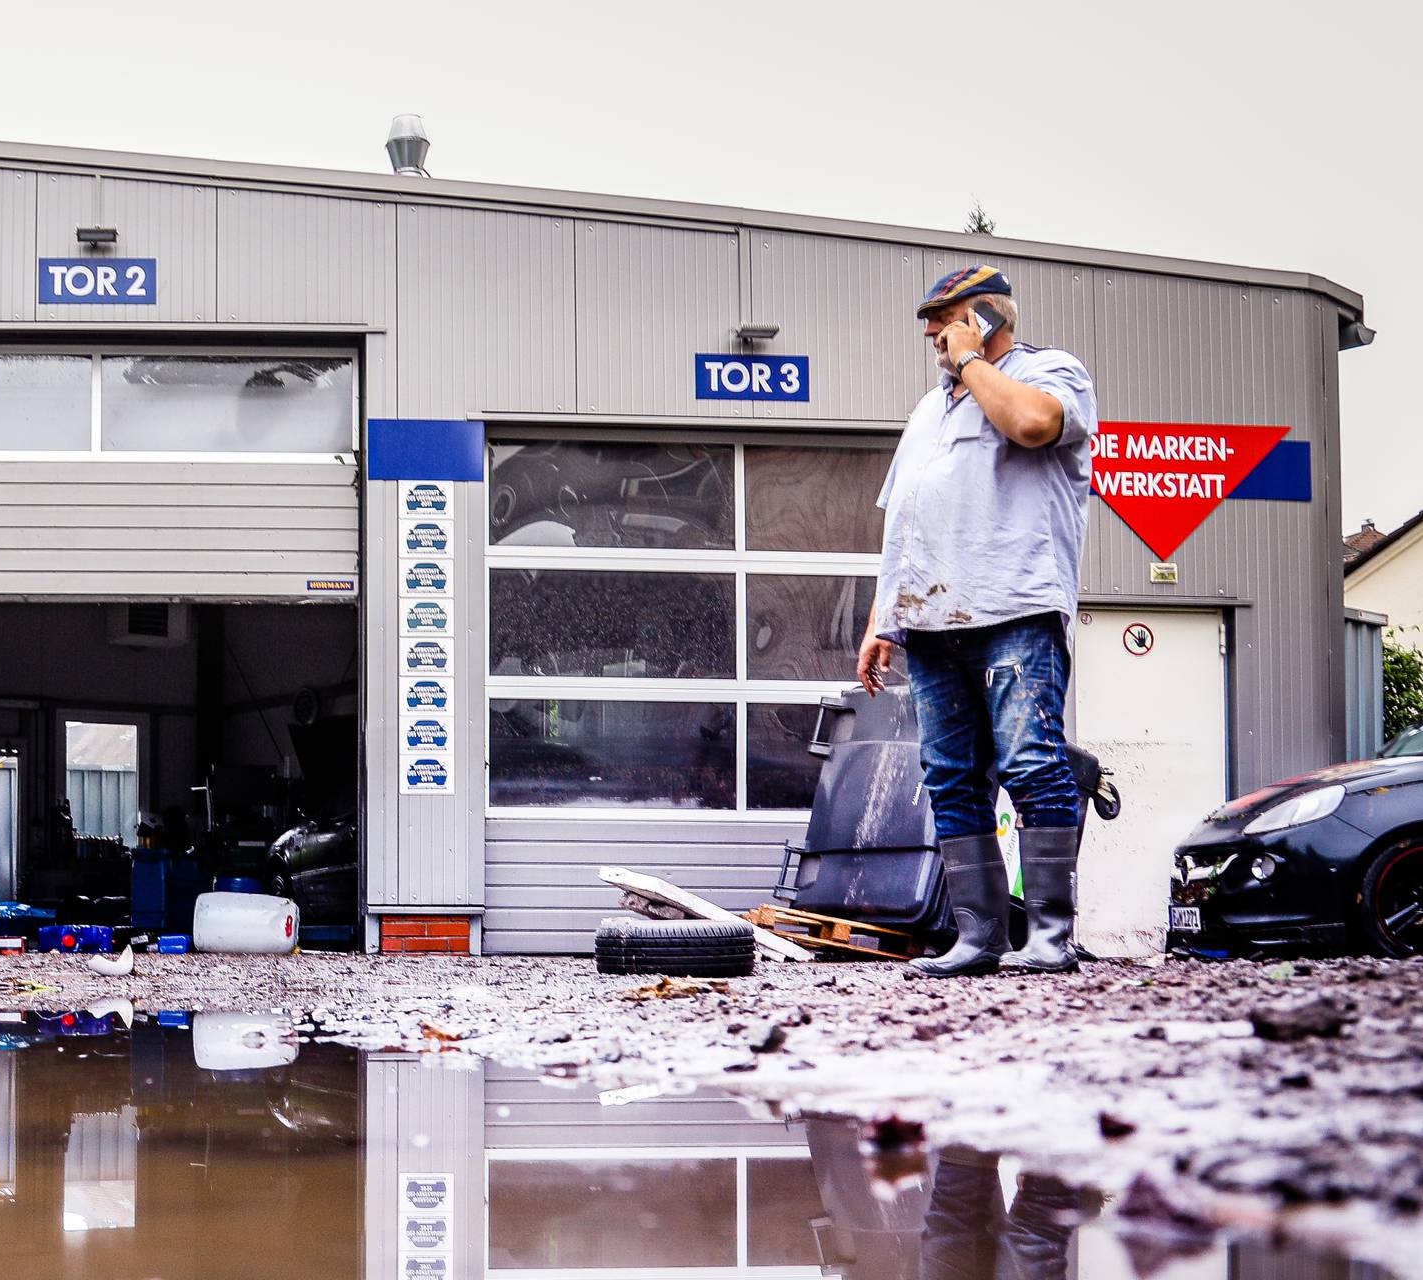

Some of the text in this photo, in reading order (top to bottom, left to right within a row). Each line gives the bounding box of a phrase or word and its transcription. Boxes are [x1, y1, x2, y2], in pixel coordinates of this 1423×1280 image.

[48, 265, 146, 296] TOR 2
[704, 361, 801, 394] TOR 3
[1125, 434, 1235, 462] MARKEN-
[1094, 470, 1226, 499] WERKSTATT
